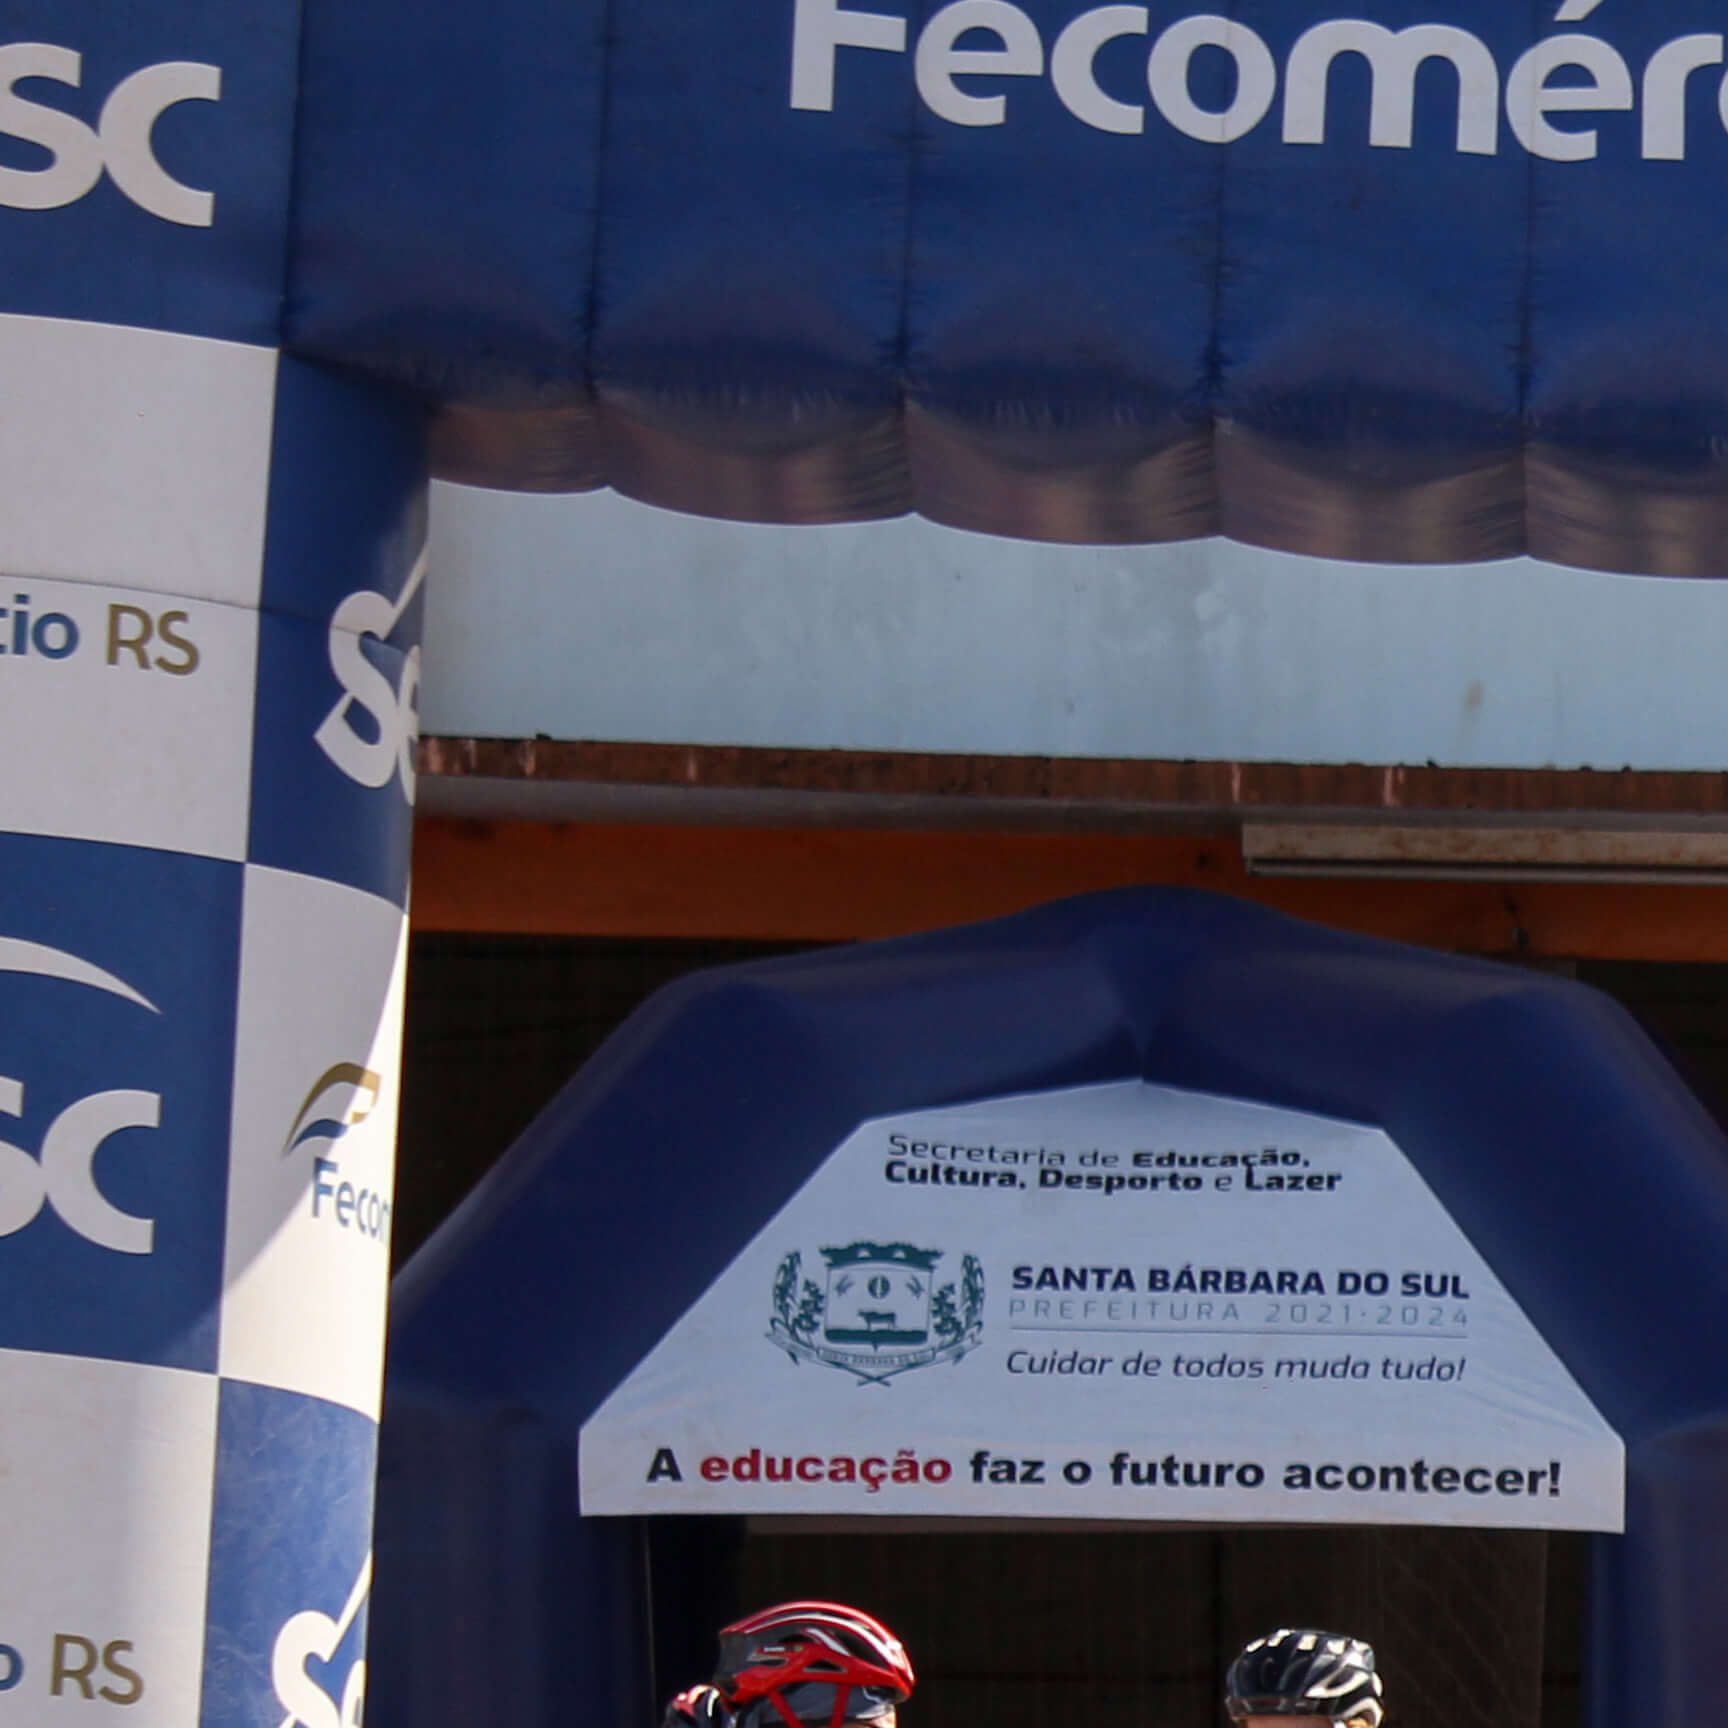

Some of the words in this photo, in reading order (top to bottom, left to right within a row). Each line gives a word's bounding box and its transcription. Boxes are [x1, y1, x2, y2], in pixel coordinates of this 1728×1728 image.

[0, 593, 80, 660] io
[107, 603, 200, 676] RS
[888, 1133, 1065, 1167] Secretaria
[1079, 1150, 1119, 1168] de
[1132, 1147, 1310, 1173] Educação,
[884, 1160, 1026, 1190] Cultura,
[1039, 1167, 1202, 1195] Desporto
[1214, 1175, 1233, 1192] e
[1245, 1166, 1343, 1192] Lazer
[1011, 1266, 1135, 1293] SANTA
[1147, 1262, 1325, 1296] BÁRBARA
[1338, 1271, 1390, 1297] DO
[1400, 1273, 1470, 1299] SUL
[1008, 1300, 1241, 1323] PREFEITURA
[1007, 1350, 1114, 1376] Cuidar
[1120, 1352, 1162, 1377] de
[1172, 1352, 1264, 1378] todos
[1274, 1355, 1370, 1381] muda
[1380, 1354, 1466, 1383] tudo!
[646, 1448, 683, 1483] A
[700, 1447, 952, 1492] educação
[970, 1451, 1047, 1485] faz
[1063, 1459, 1093, 1487] o
[1110, 1451, 1266, 1489] futuro
[1282, 1458, 1561, 1497] acontecer!
[51, 1633, 144, 1705] RS
